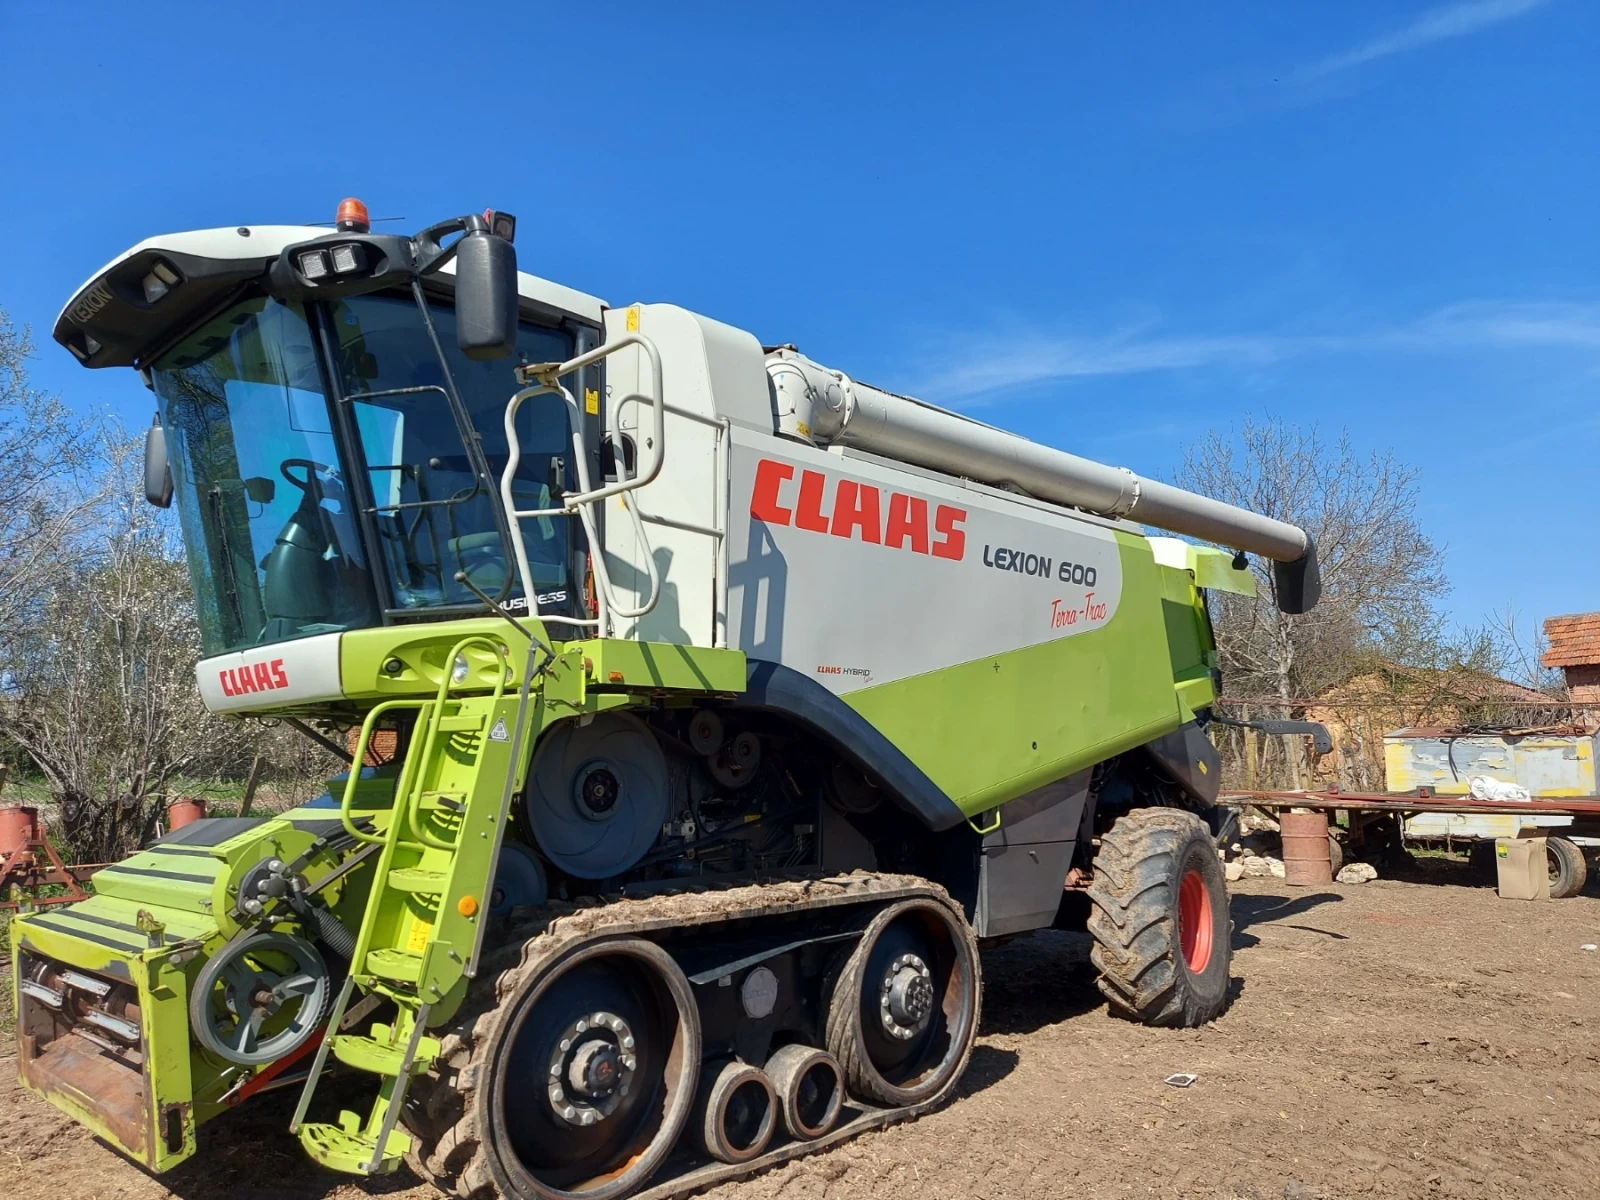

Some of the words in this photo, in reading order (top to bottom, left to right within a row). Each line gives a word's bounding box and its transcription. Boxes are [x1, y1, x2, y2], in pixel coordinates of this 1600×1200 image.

[71, 284, 113, 323] LEXION
[750, 459, 967, 562] CLAAS
[983, 544, 1052, 579] LEXION
[1058, 561, 1097, 588] 600
[492, 590, 567, 613] USIESS
[219, 658, 289, 697] CLAAS
[817, 665, 842, 675] CLAAS
[842, 667, 870, 677] HYBRID
